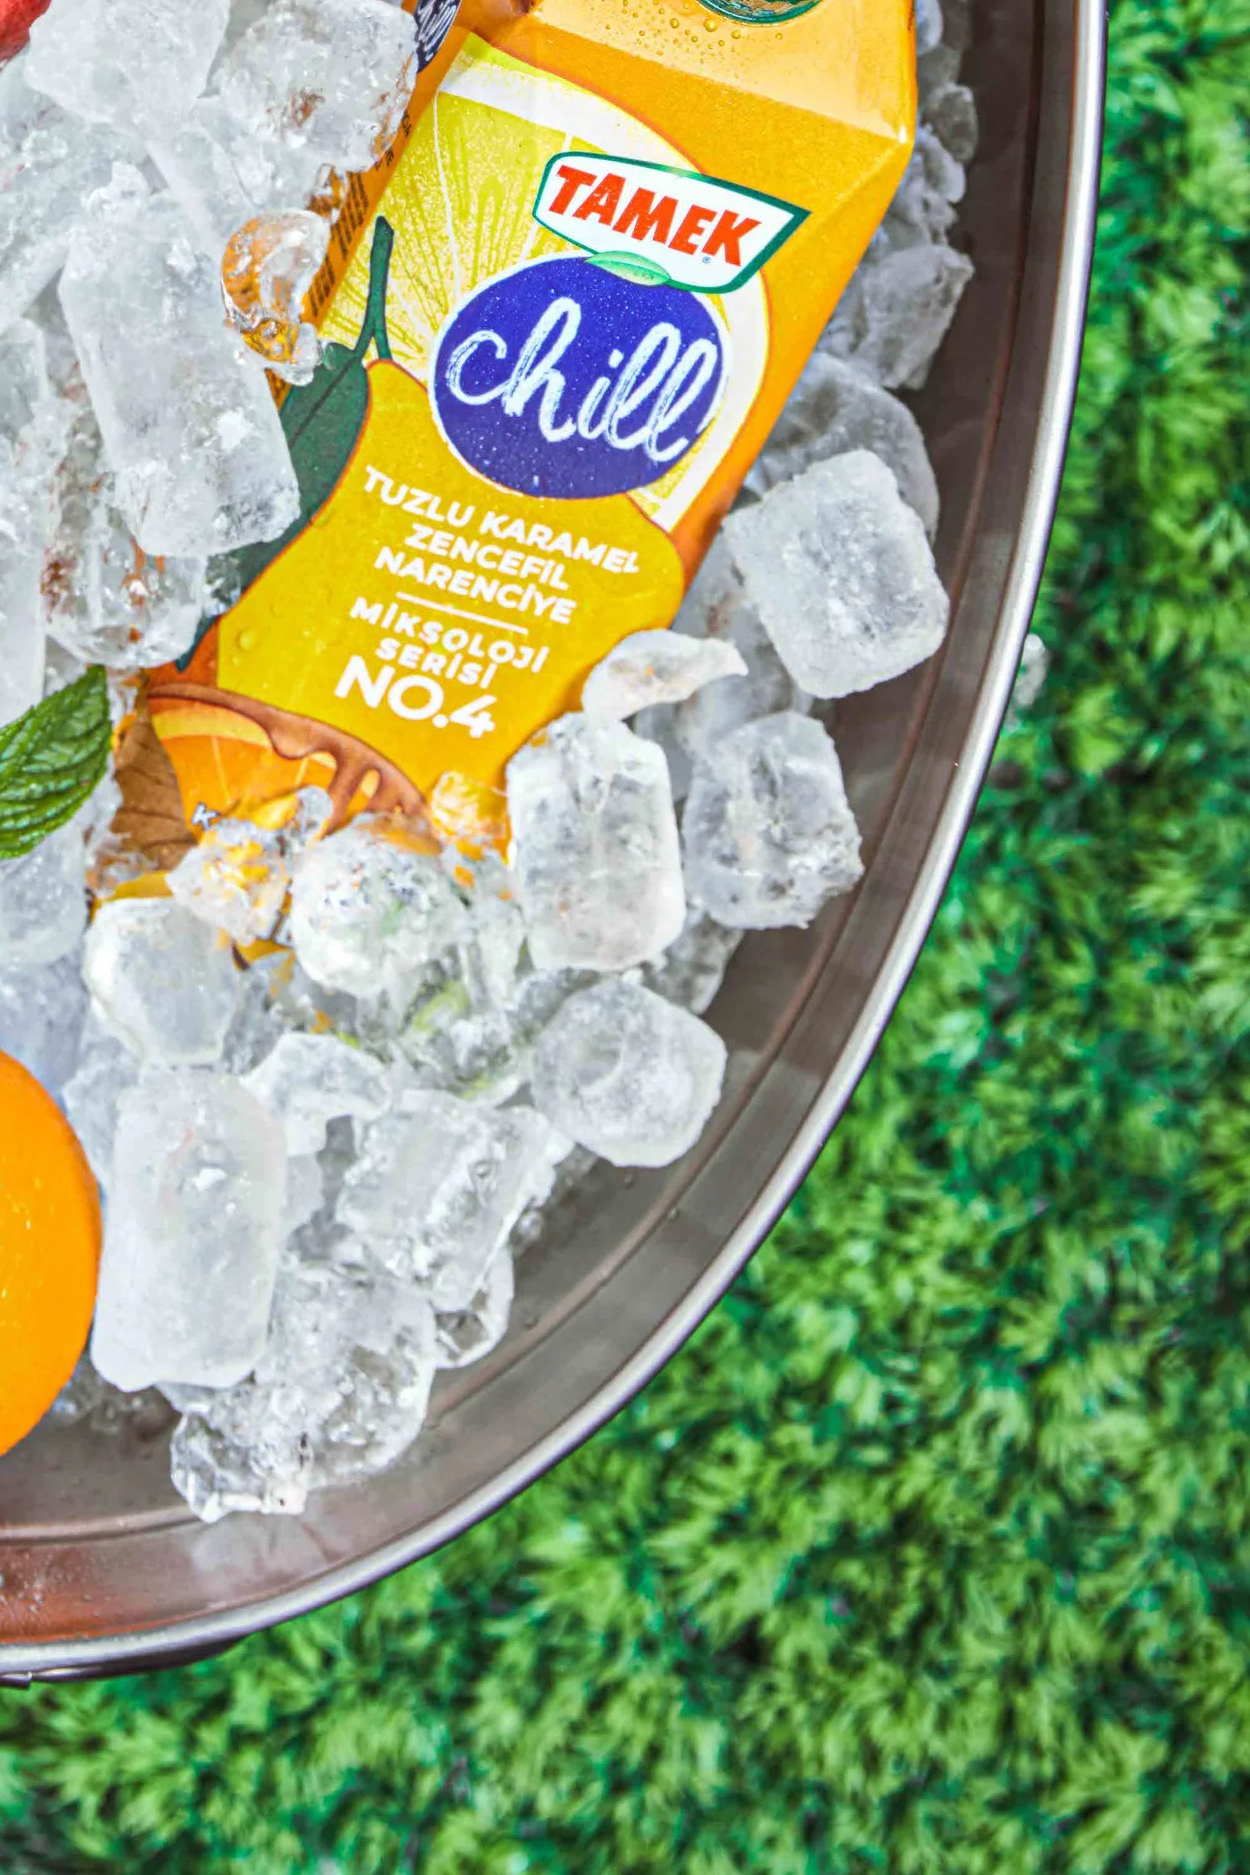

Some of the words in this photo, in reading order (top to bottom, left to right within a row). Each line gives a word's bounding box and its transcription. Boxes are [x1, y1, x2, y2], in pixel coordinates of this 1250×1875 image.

[548, 164, 763, 267] TAMEK
[447, 296, 718, 462] chill
[363, 465, 476, 526] TUZLU
[479, 511, 640, 574] KARAMEL
[404, 523, 570, 591] ZENCEFİL
[374, 546, 577, 625] NARENCİYE
[350, 596, 550, 673] MİKSOLOJİ
[375, 638, 498, 689] SERİSİ
[334, 655, 498, 738] NO.4
